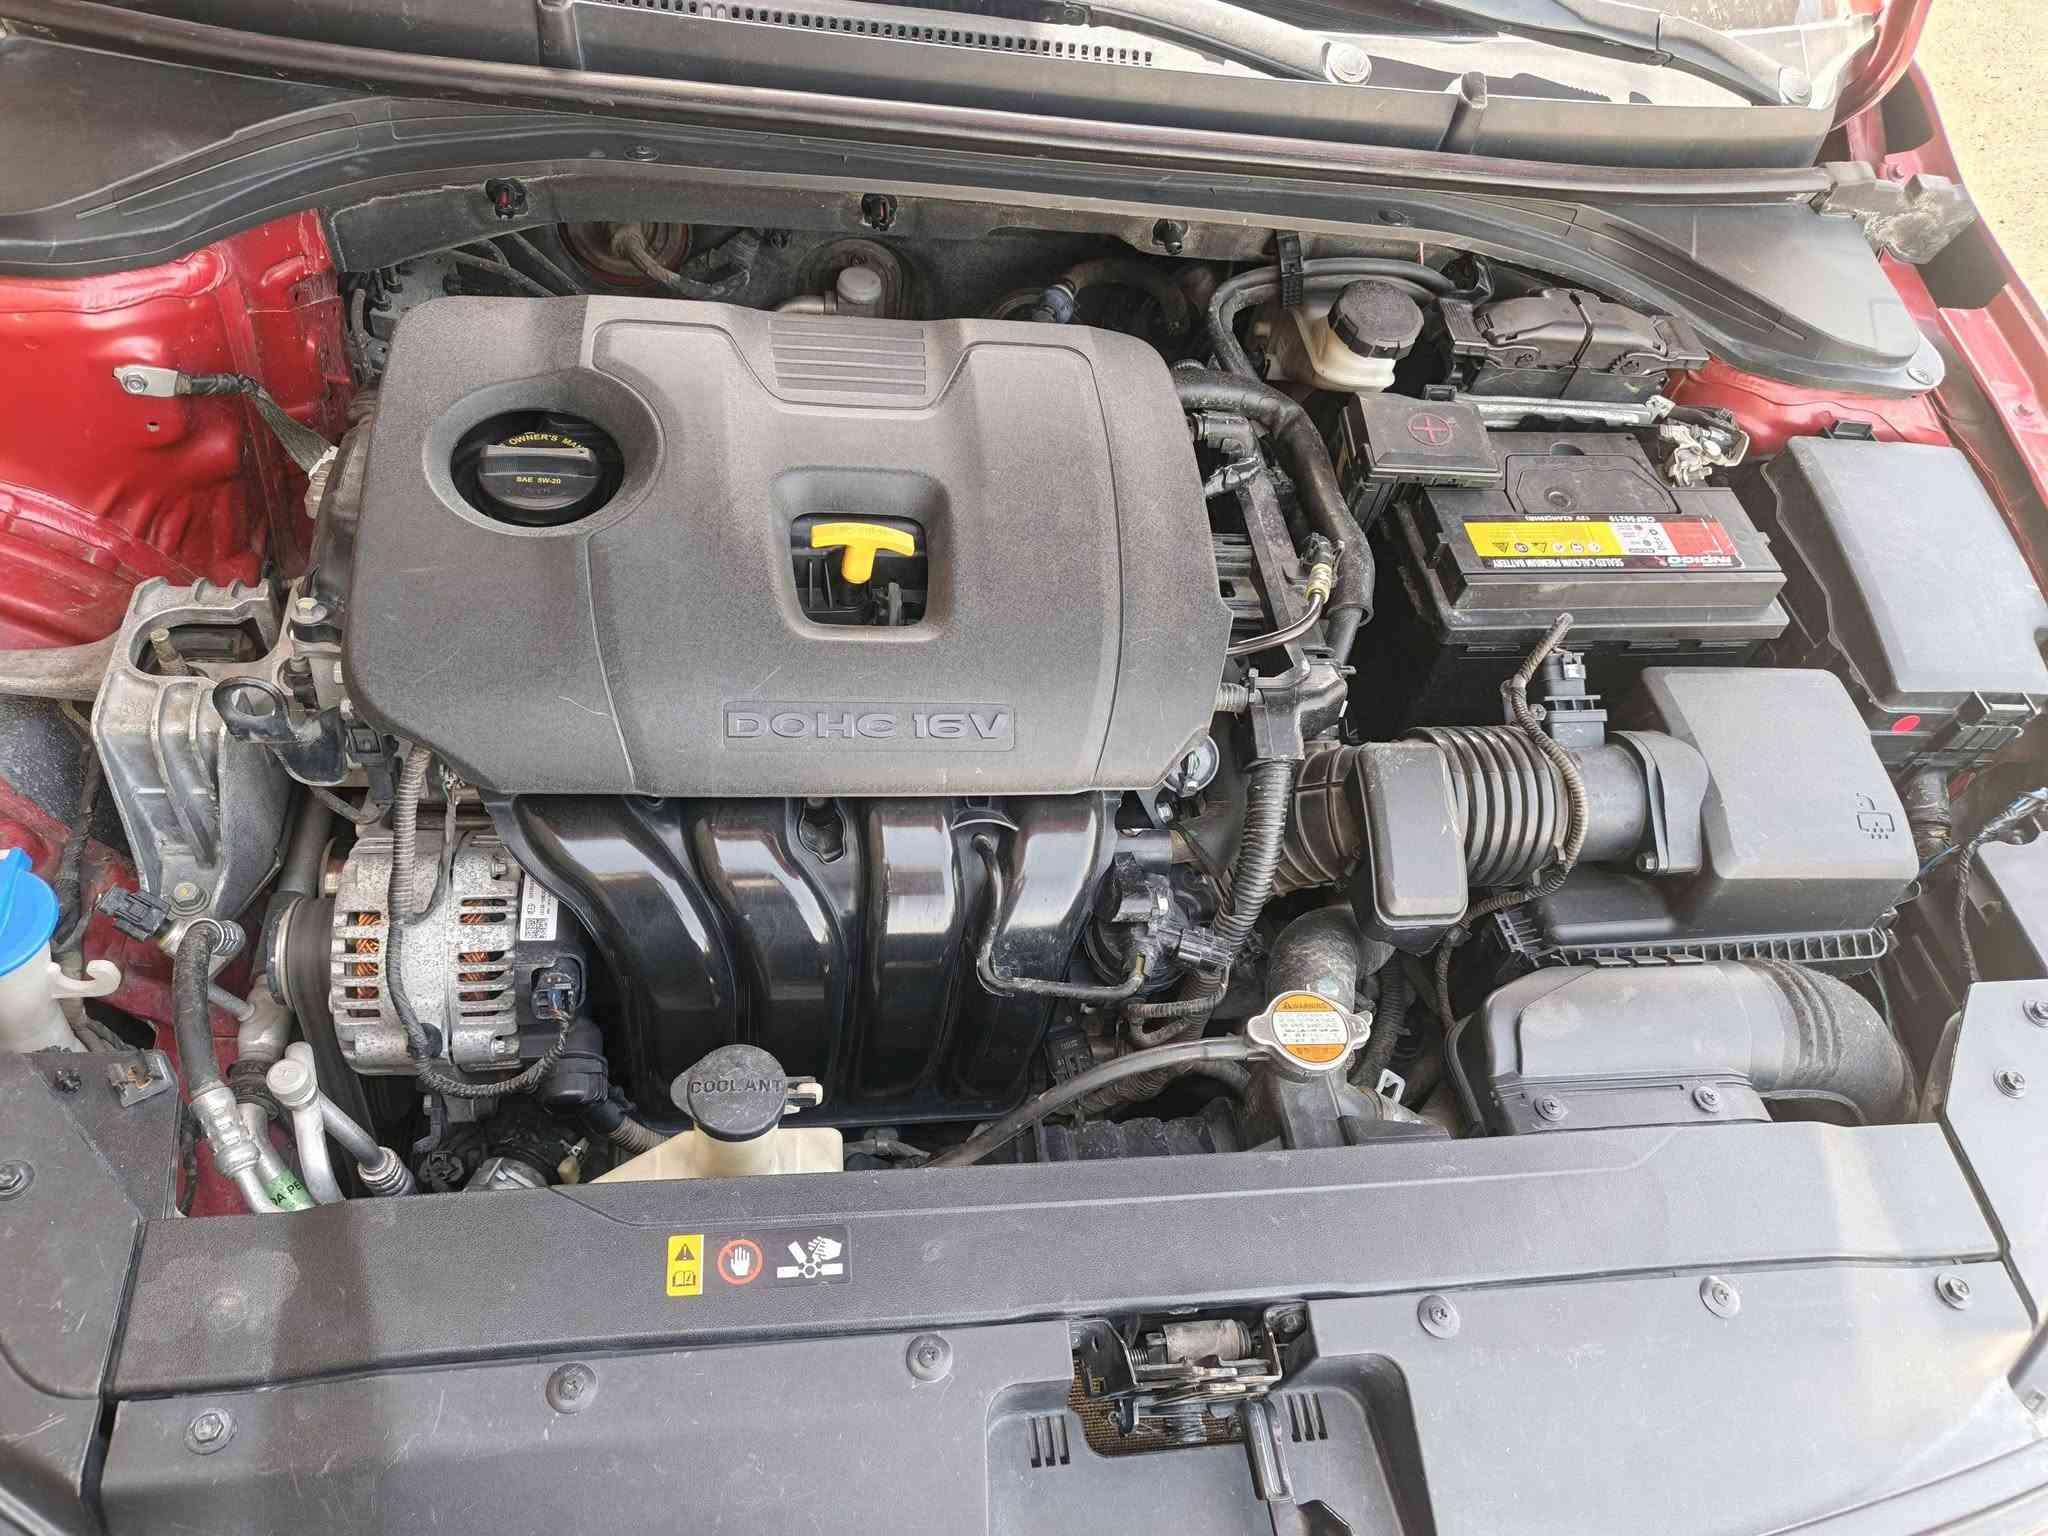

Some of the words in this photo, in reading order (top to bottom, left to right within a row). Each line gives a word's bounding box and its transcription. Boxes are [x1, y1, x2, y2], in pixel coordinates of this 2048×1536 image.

[509, 433, 558, 445] OWNER'S
[1493, 558, 1526, 568] BATTERY
[1526, 558, 1561, 568] PREMIUM
[1561, 558, 1595, 568] CALCIUM
[1595, 558, 1625, 568] SEALED
[727, 711, 897, 738] DOHC
[912, 711, 1009, 739] 16V
[690, 1078, 784, 1094] COOLANT
